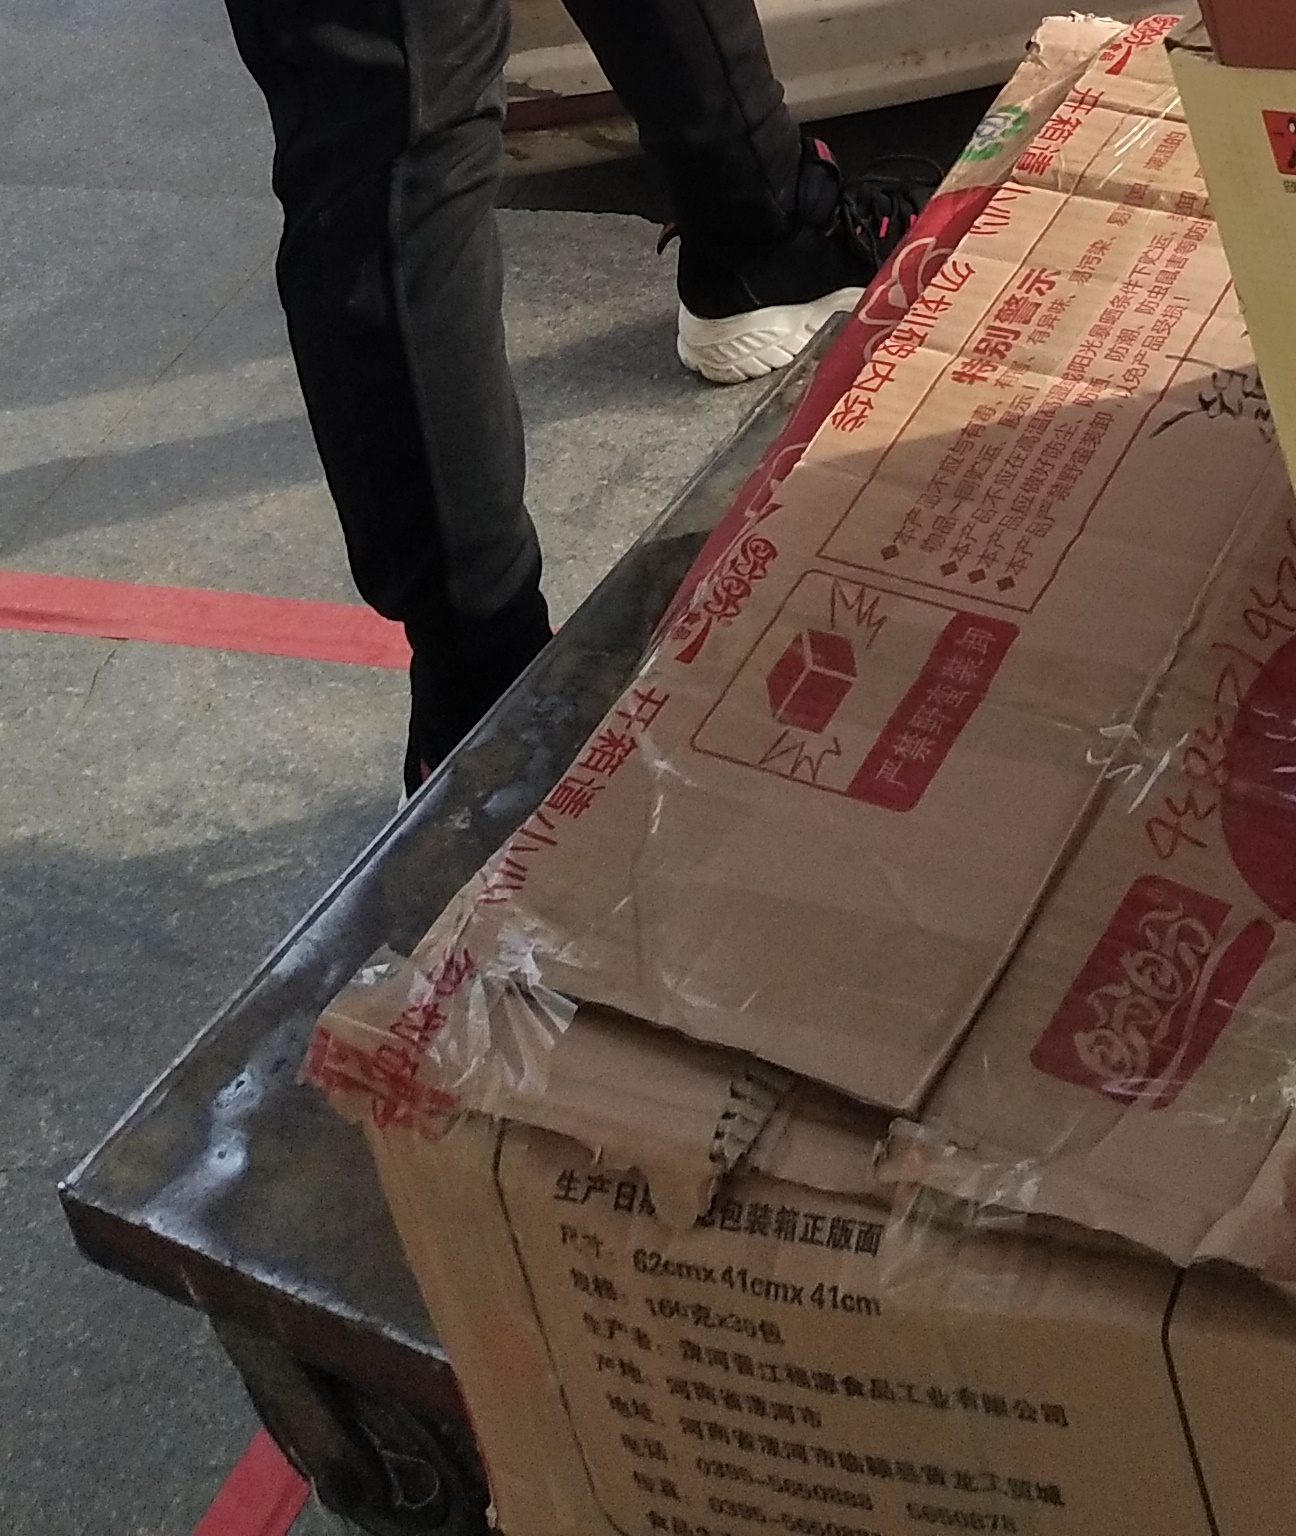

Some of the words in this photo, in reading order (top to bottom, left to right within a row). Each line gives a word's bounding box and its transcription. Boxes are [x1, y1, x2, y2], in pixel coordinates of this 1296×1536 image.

[951, 264, 1062, 388] 特别警示
[875, 624, 1000, 794] 严禁野蛮装卸
